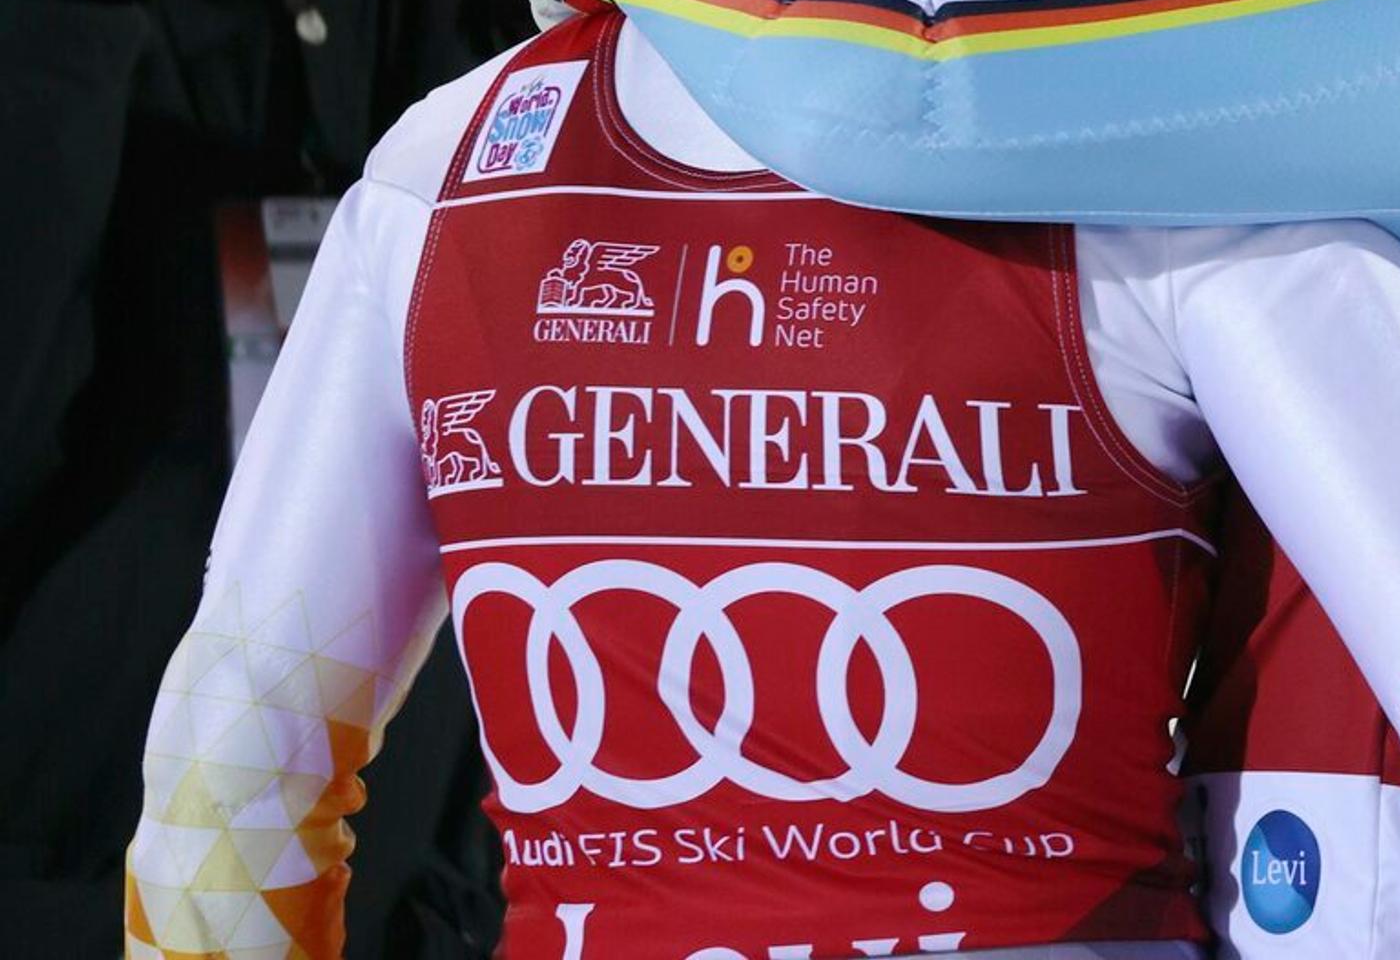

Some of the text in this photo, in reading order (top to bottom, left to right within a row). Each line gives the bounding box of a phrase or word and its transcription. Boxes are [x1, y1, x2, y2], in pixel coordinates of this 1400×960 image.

[485, 142, 519, 168] Day
[784, 243, 833, 266] The
[780, 271, 878, 295] Human
[776, 297, 867, 326] Safety
[533, 320, 652, 345] GENERALI
[775, 324, 825, 348] Net
[507, 385, 1088, 498] GENERALI
[578, 828, 663, 868] FIS
[674, 826, 746, 863] Ski
[1252, 850, 1308, 887] Levi
